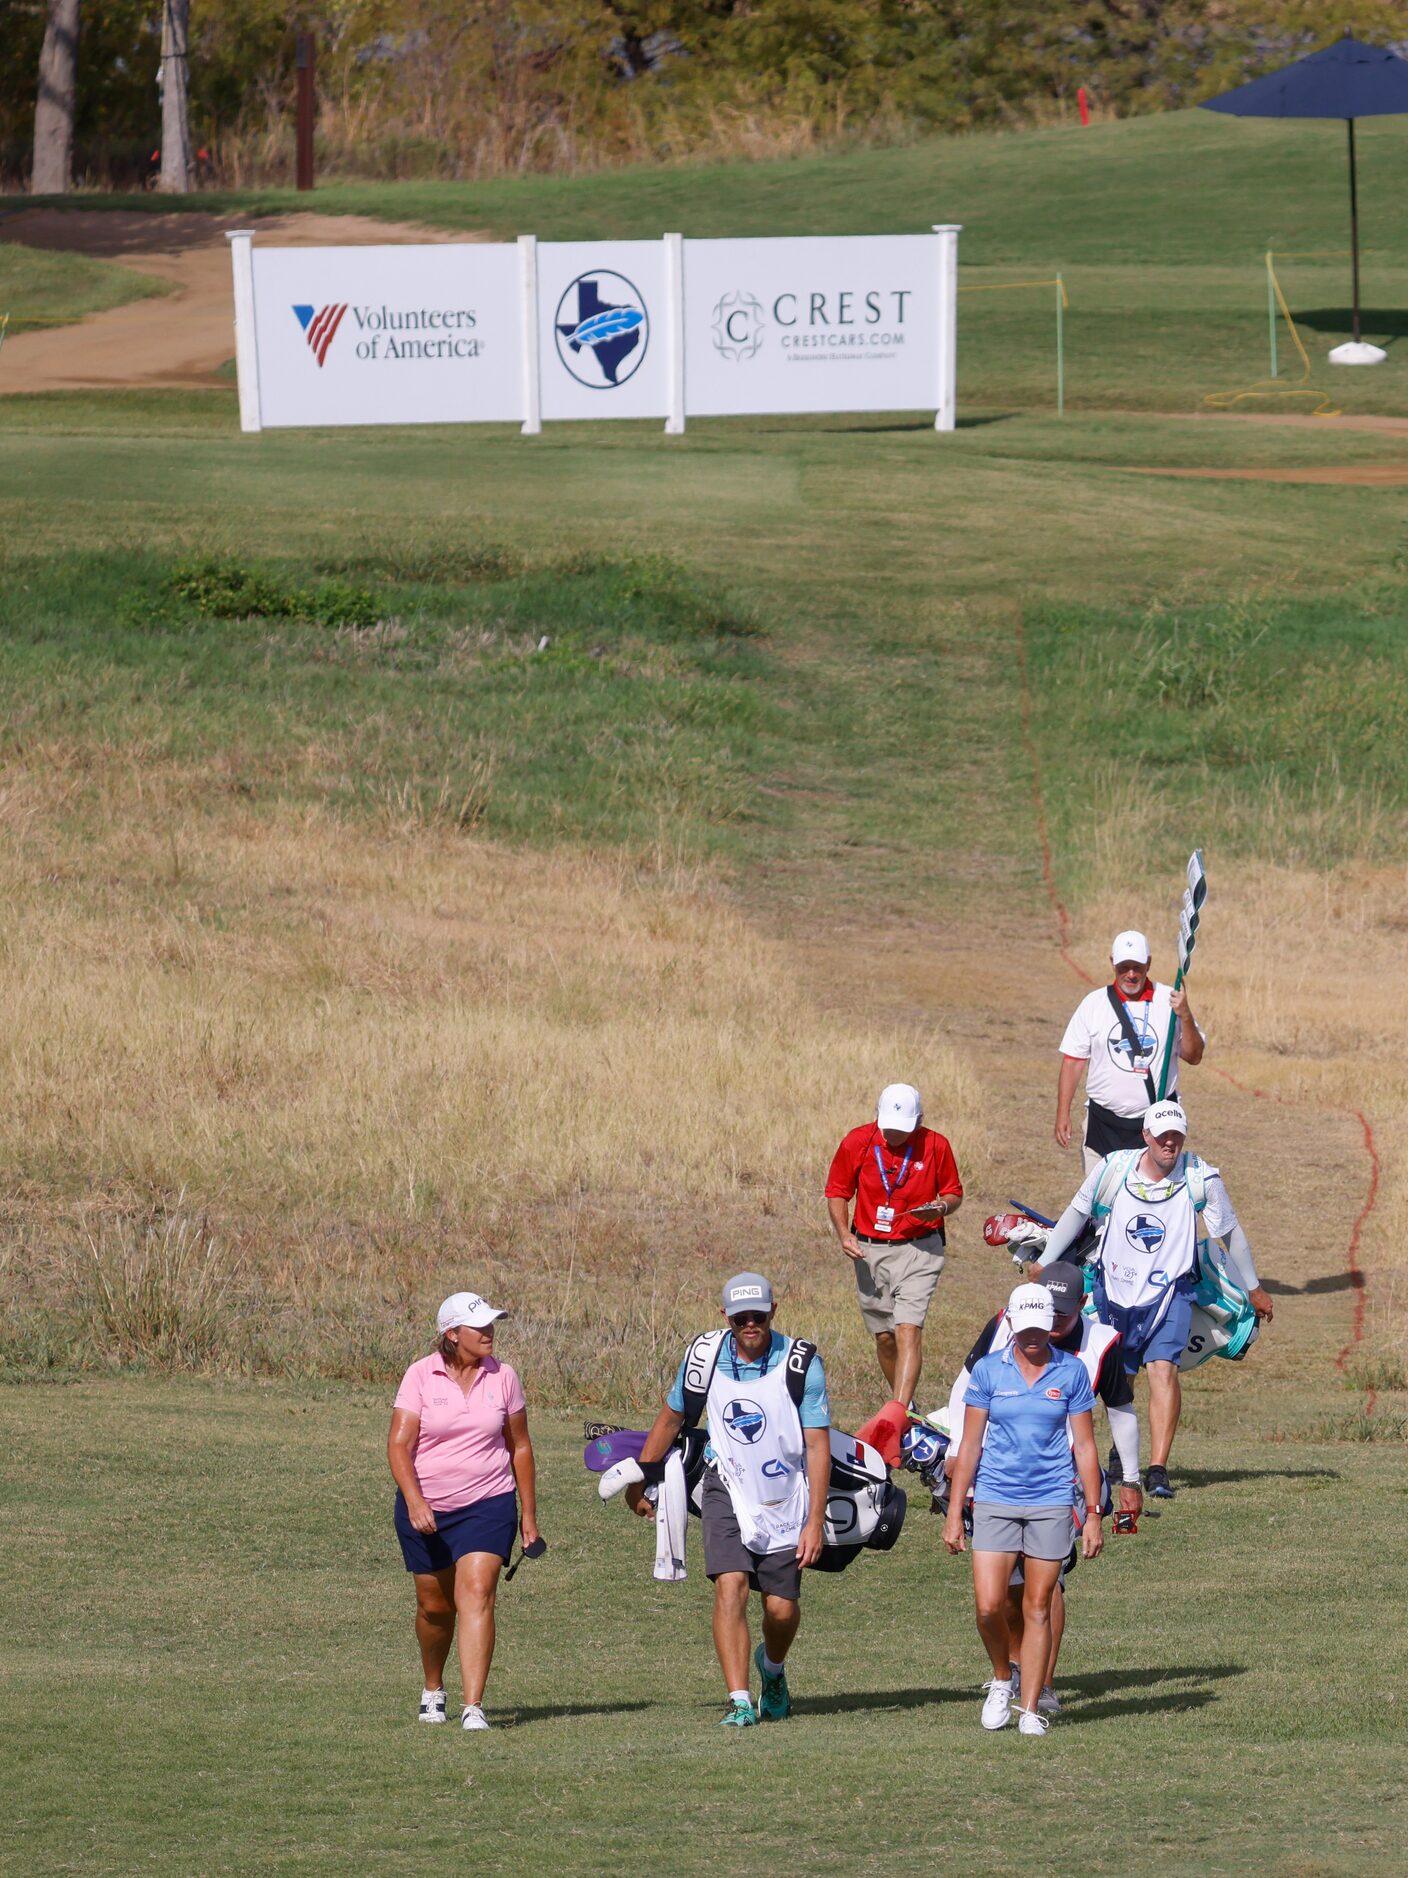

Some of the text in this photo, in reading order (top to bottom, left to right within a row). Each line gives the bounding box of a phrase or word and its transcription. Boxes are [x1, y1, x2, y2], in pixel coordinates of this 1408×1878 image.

[353, 304, 477, 330] Volunteers
[772, 291, 912, 327] CREST
[355, 333, 481, 359] of America
[780, 332, 905, 348] CRESTCARS.COM
[732, 1287, 760, 1299] PING
[1046, 1284, 1067, 1293] KPMG
[1019, 1302, 1045, 1310] KPMG
